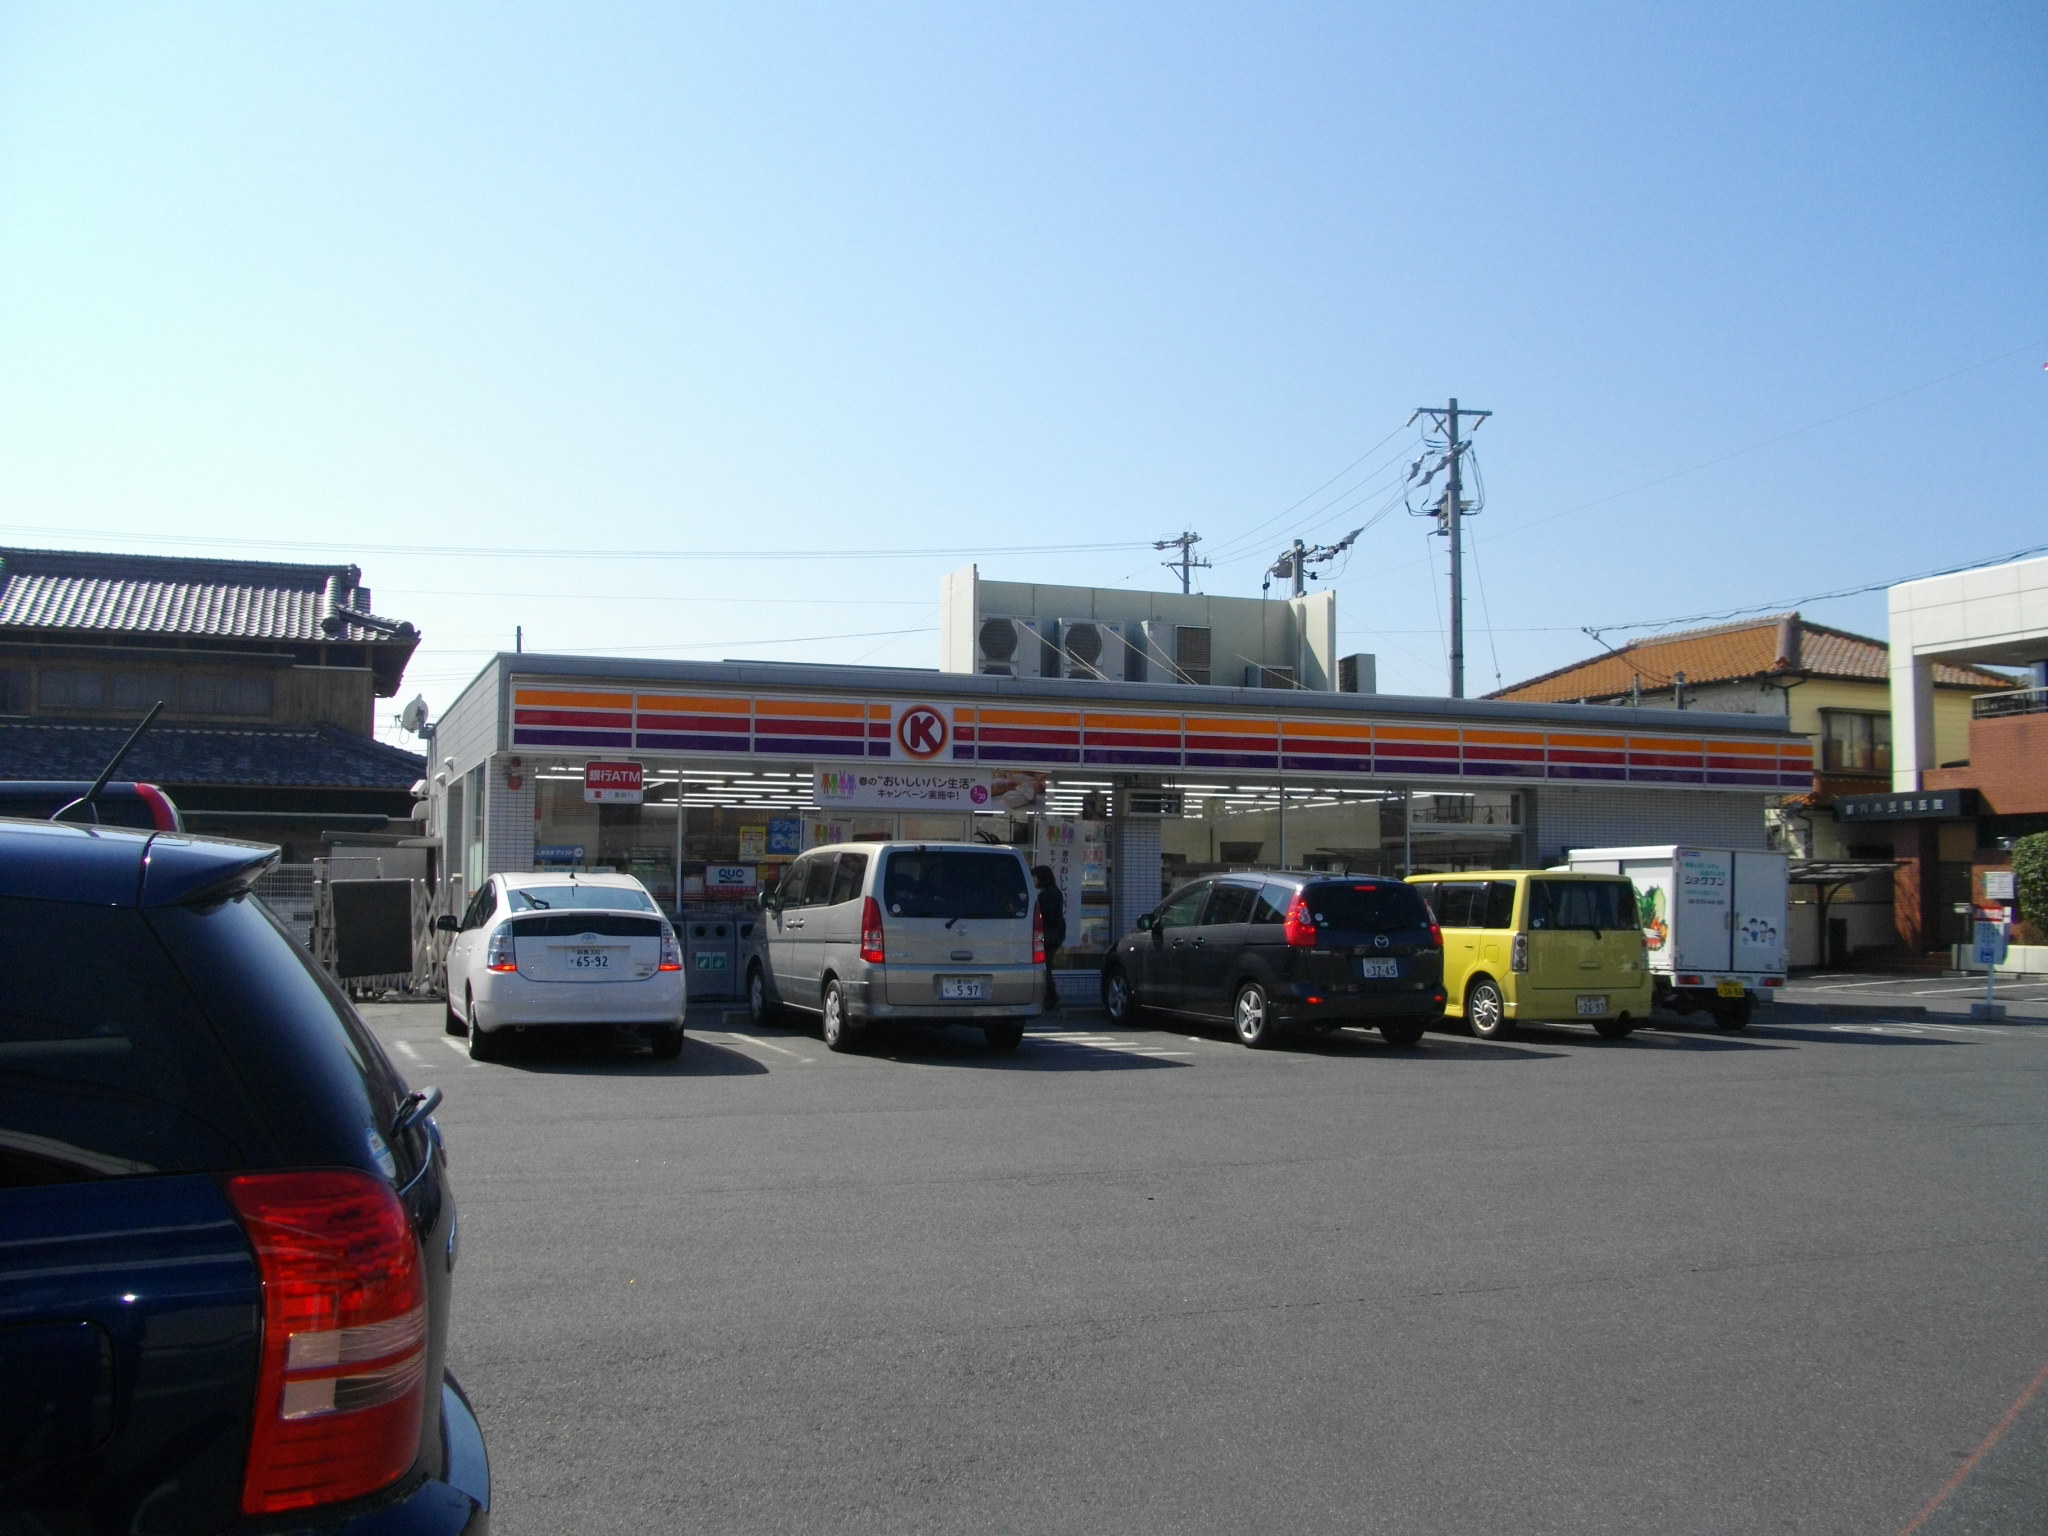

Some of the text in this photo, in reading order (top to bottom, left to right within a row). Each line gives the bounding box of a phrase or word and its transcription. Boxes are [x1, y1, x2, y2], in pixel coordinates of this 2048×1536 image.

[910, 715, 940, 752] K
[589, 769, 641, 783] 銀行ATM
[718, 868, 744, 880] QUO
[576, 955, 608, 967] 65-92
